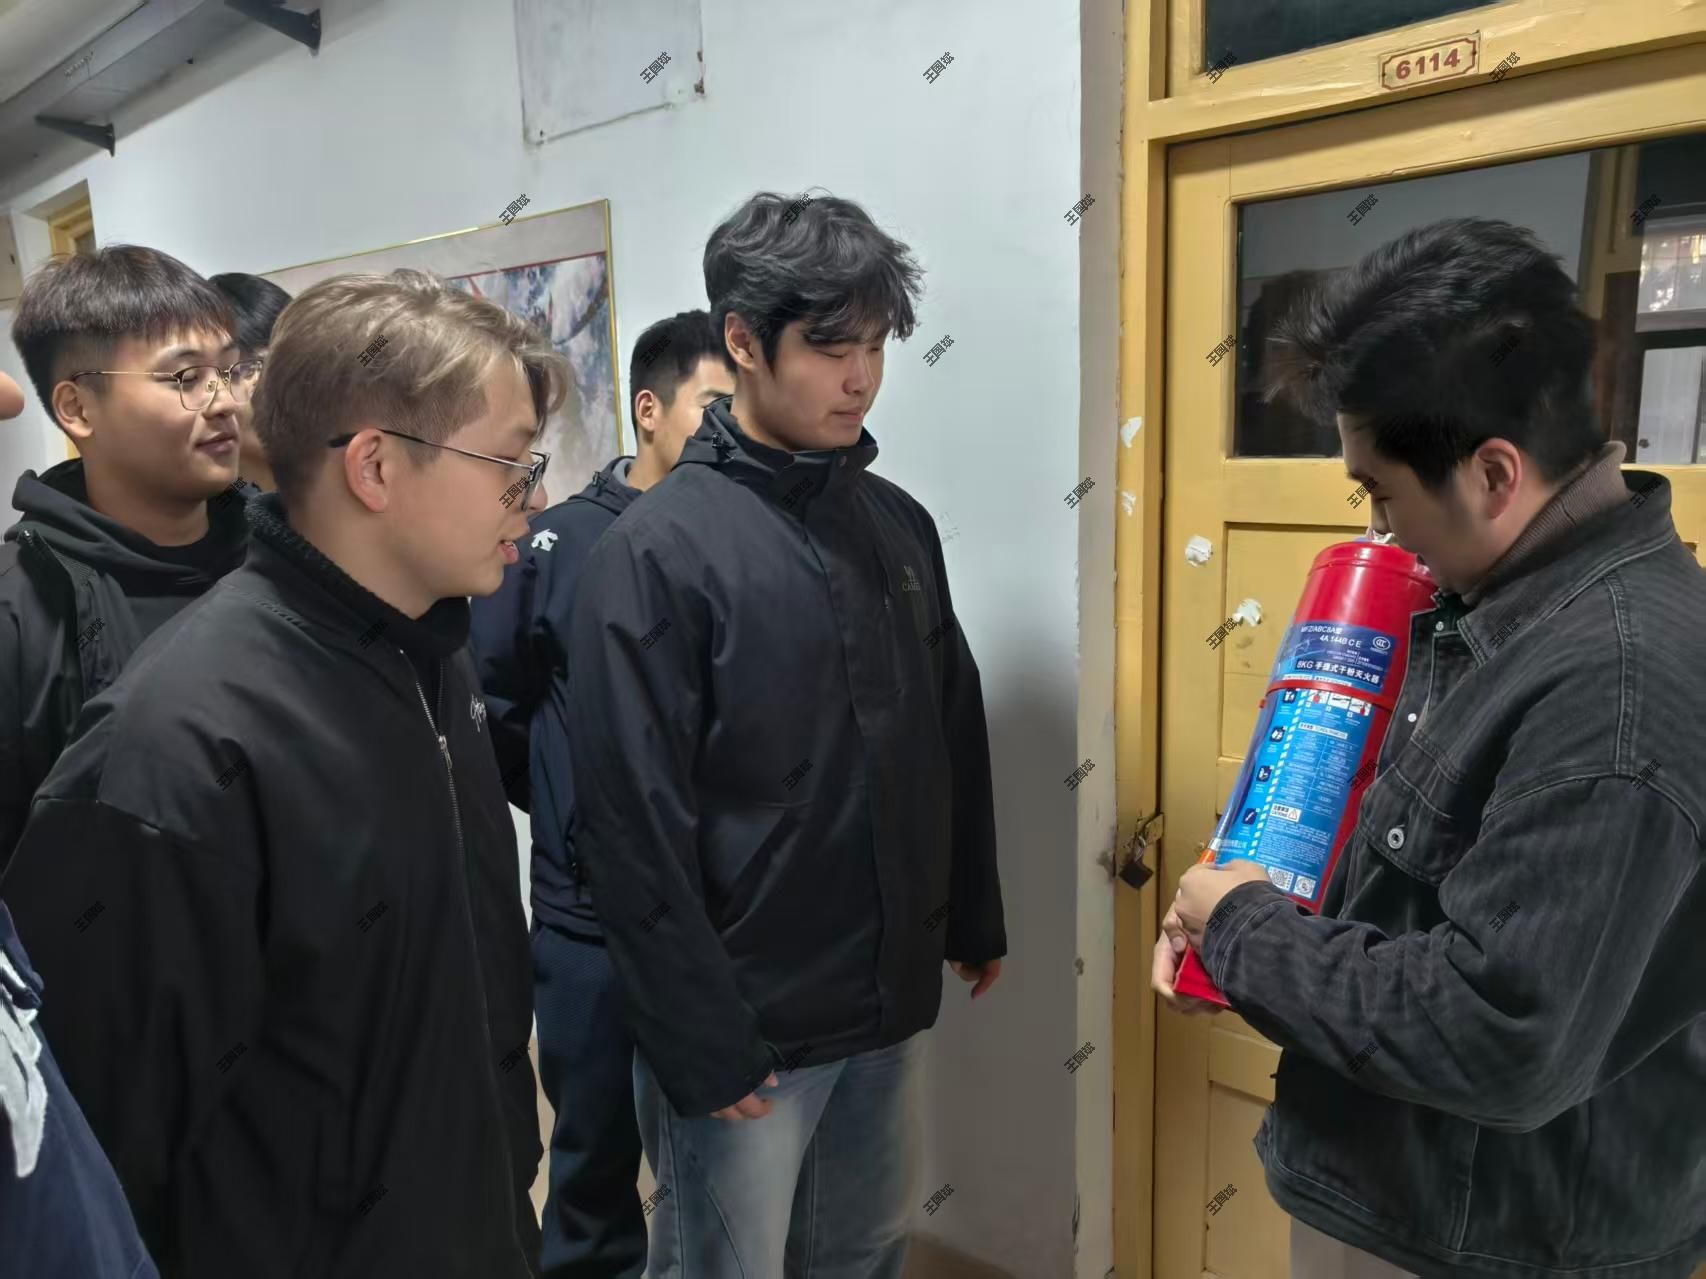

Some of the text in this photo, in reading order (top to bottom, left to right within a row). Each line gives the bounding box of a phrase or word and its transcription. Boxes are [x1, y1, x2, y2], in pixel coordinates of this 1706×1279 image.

[1395, 48, 1460, 80] 6114
[1355, 640, 1362, 648] E
[1314, 661, 1381, 685] 手提式干粉灭火器
